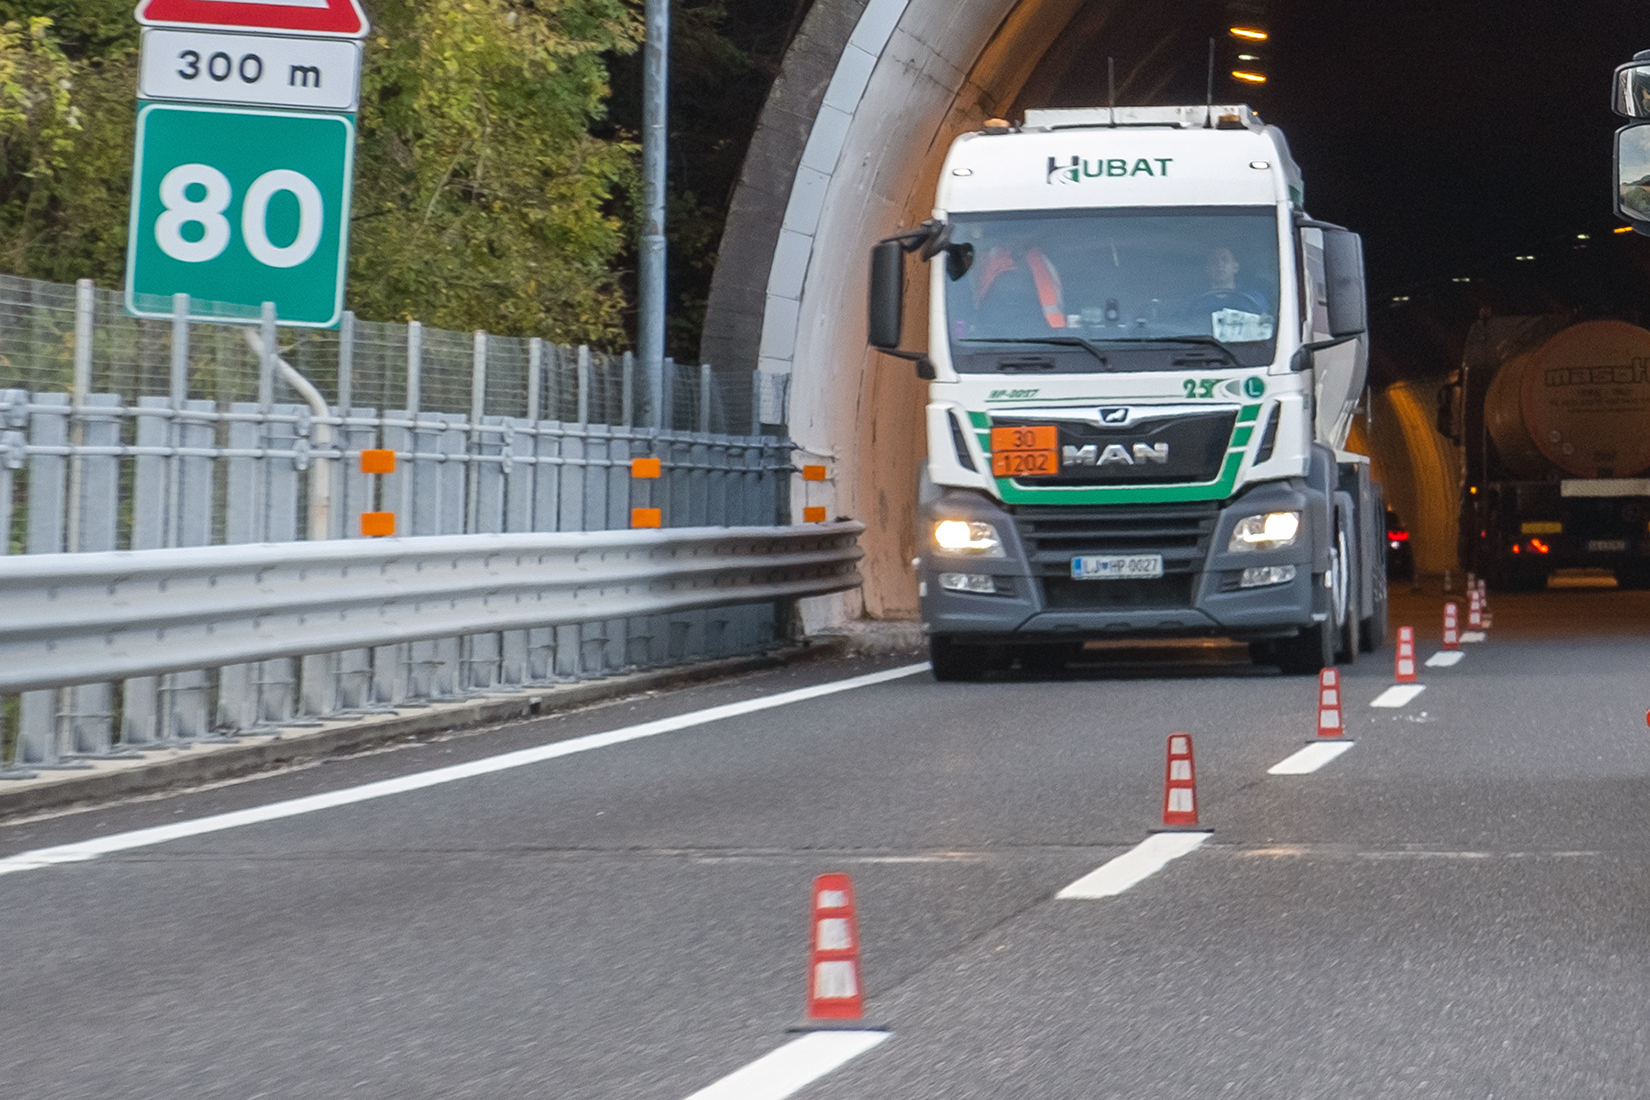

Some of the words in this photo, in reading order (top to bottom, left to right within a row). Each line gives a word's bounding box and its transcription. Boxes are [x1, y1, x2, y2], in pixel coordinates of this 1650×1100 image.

[177, 50, 263, 84] 300
[289, 63, 321, 88] m
[1046, 155, 1173, 185] HUBAT
[154, 163, 324, 269] 80
[1013, 430, 1036, 448] 30
[1005, 454, 1049, 473] 1202
[1062, 442, 1169, 467] MAN
